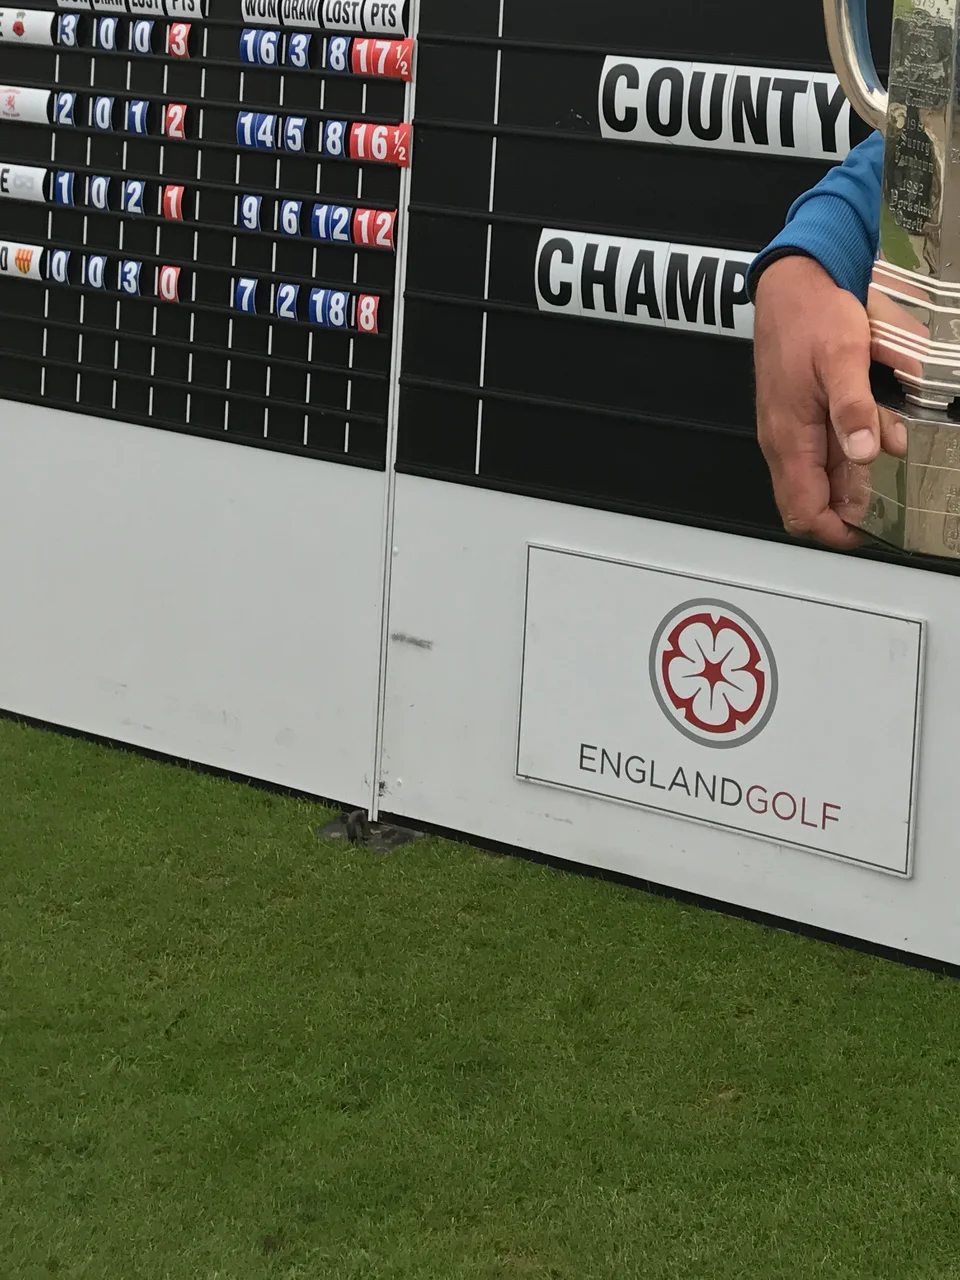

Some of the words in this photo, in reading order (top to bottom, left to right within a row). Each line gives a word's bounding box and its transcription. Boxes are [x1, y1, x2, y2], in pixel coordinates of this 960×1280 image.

[62, 15, 76, 47] 3
[101, 18, 115, 50] 0
[135, 21, 151, 53] 0
[171, 24, 186, 56] 3
[243, 29, 276, 65] 16
[291, 34, 307, 67] 3
[330, 36, 347, 71] 8
[326, 0, 360, 25] LOST
[370, 2, 397, 28] PTS
[58, 93, 73, 126] 2
[96, 97, 111, 130] 0
[131, 101, 144, 134] 1
[168, 106, 184, 138] 2
[240, 113, 274, 148] 14
[286, 118, 303, 151] 5
[326, 121, 343, 156] 8
[601, 62, 847, 154] COUNTY
[58, 172, 70, 204] 1
[91, 176, 106, 209] 0
[126, 181, 142, 214] 2
[166, 185, 179, 218] 1
[242, 196, 258, 231] 9
[282, 200, 298, 235] 6
[315, 206, 350, 242] 12
[356, 210, 393, 248] 12
[52, 250, 67, 283] 0
[88, 255, 103, 289] 0
[123, 260, 138, 294] 3
[161, 265, 177, 300] 0
[238, 278, 254, 313] 7
[279, 284, 296, 319] 2
[312, 289, 346, 327] 18
[359, 294, 376, 331] 8
[579, 743, 841, 830] ENGLANDGOLF
